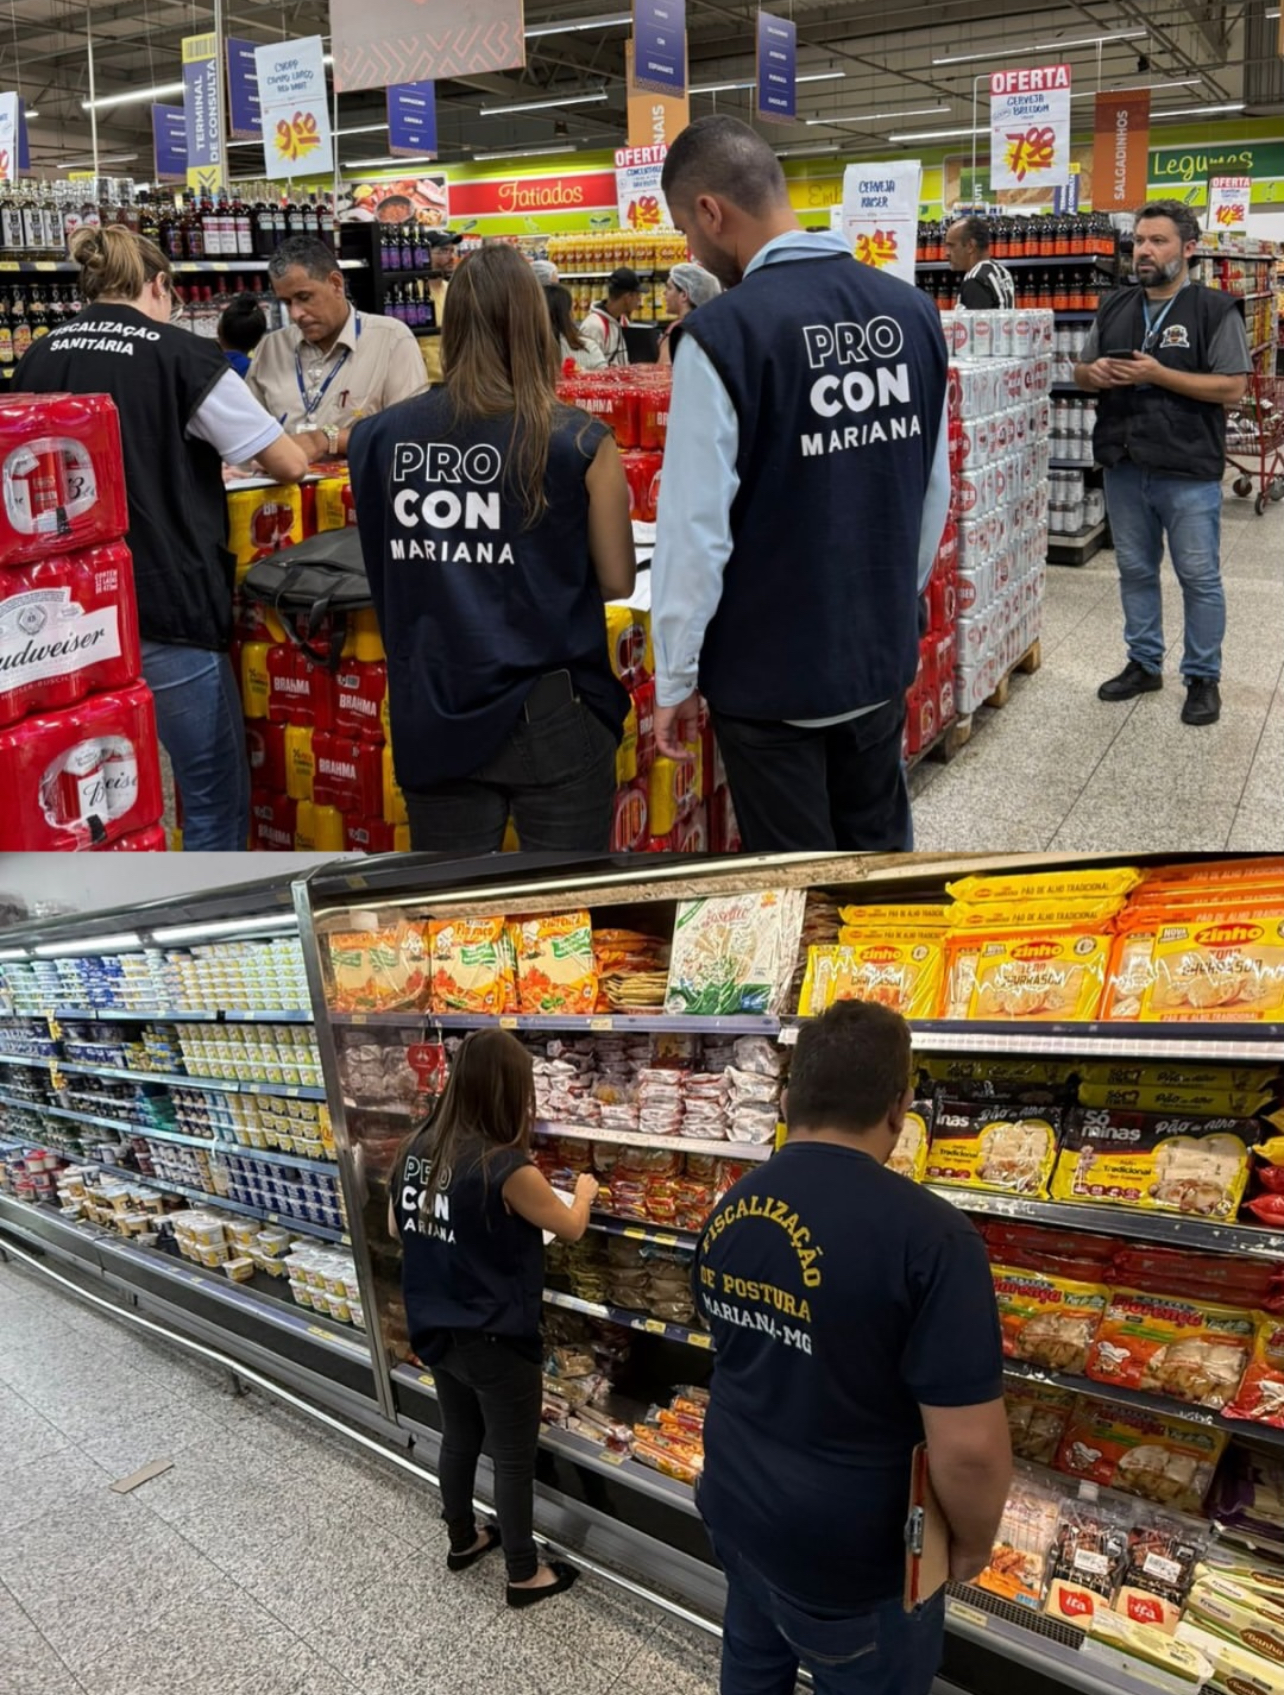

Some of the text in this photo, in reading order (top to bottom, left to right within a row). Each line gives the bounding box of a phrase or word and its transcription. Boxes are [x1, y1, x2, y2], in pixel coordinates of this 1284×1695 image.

[992, 67, 1068, 94] OFERTA
[194, 75, 207, 152] TERMINAL
[207, 59, 219, 163] DE CONSULTA
[1006, 94, 1045, 107] CERVEJA
[652, 104, 666, 145] NAIS
[614, 145, 668, 167] OFERTA
[1114, 110, 1128, 201] SALGADINHOS
[1153, 151, 1254, 182] Legus
[858, 180, 896, 193] CERVEJA
[1212, 177, 1251, 189] OFERTA
[498, 180, 583, 213] Fatiados
[50, 337, 134, 356] SANITÁRIA
[803, 315, 904, 369] PRO
[809, 363, 911, 418] CON
[800, 415, 922, 457] MARIANA
[393, 443, 501, 485] PRO
[393, 489, 501, 530] CON
[390, 539, 515, 565] MARIANA
[0, 628, 105, 672] udweiser
[273, 676, 310, 695] BRAHMA
[339, 694, 377, 716] BRAHMA
[319, 757, 357, 779] BRAHMA
[258, 823, 291, 845] BRAHMA
[1197, 926, 1263, 944] zinho
[861, 947, 901, 961] zinho
[1012, 942, 1064, 958] zinho
[936, 1112, 970, 1127] inas
[1083, 1109, 1110, 1126] Só
[1155, 1119, 1191, 1135] Pão
[1204, 1118, 1238, 1130] Alho
[1081, 1125, 1141, 1141] minas
[1103, 1164, 1151, 1176] Tradicional
[404, 1217, 457, 1244] ARIANA
[702, 1195, 823, 1287] FISCALIZAÇÃO
[722, 1273, 811, 1323] POSTURA
[702, 1292, 812, 1356] MARIANA-MG
